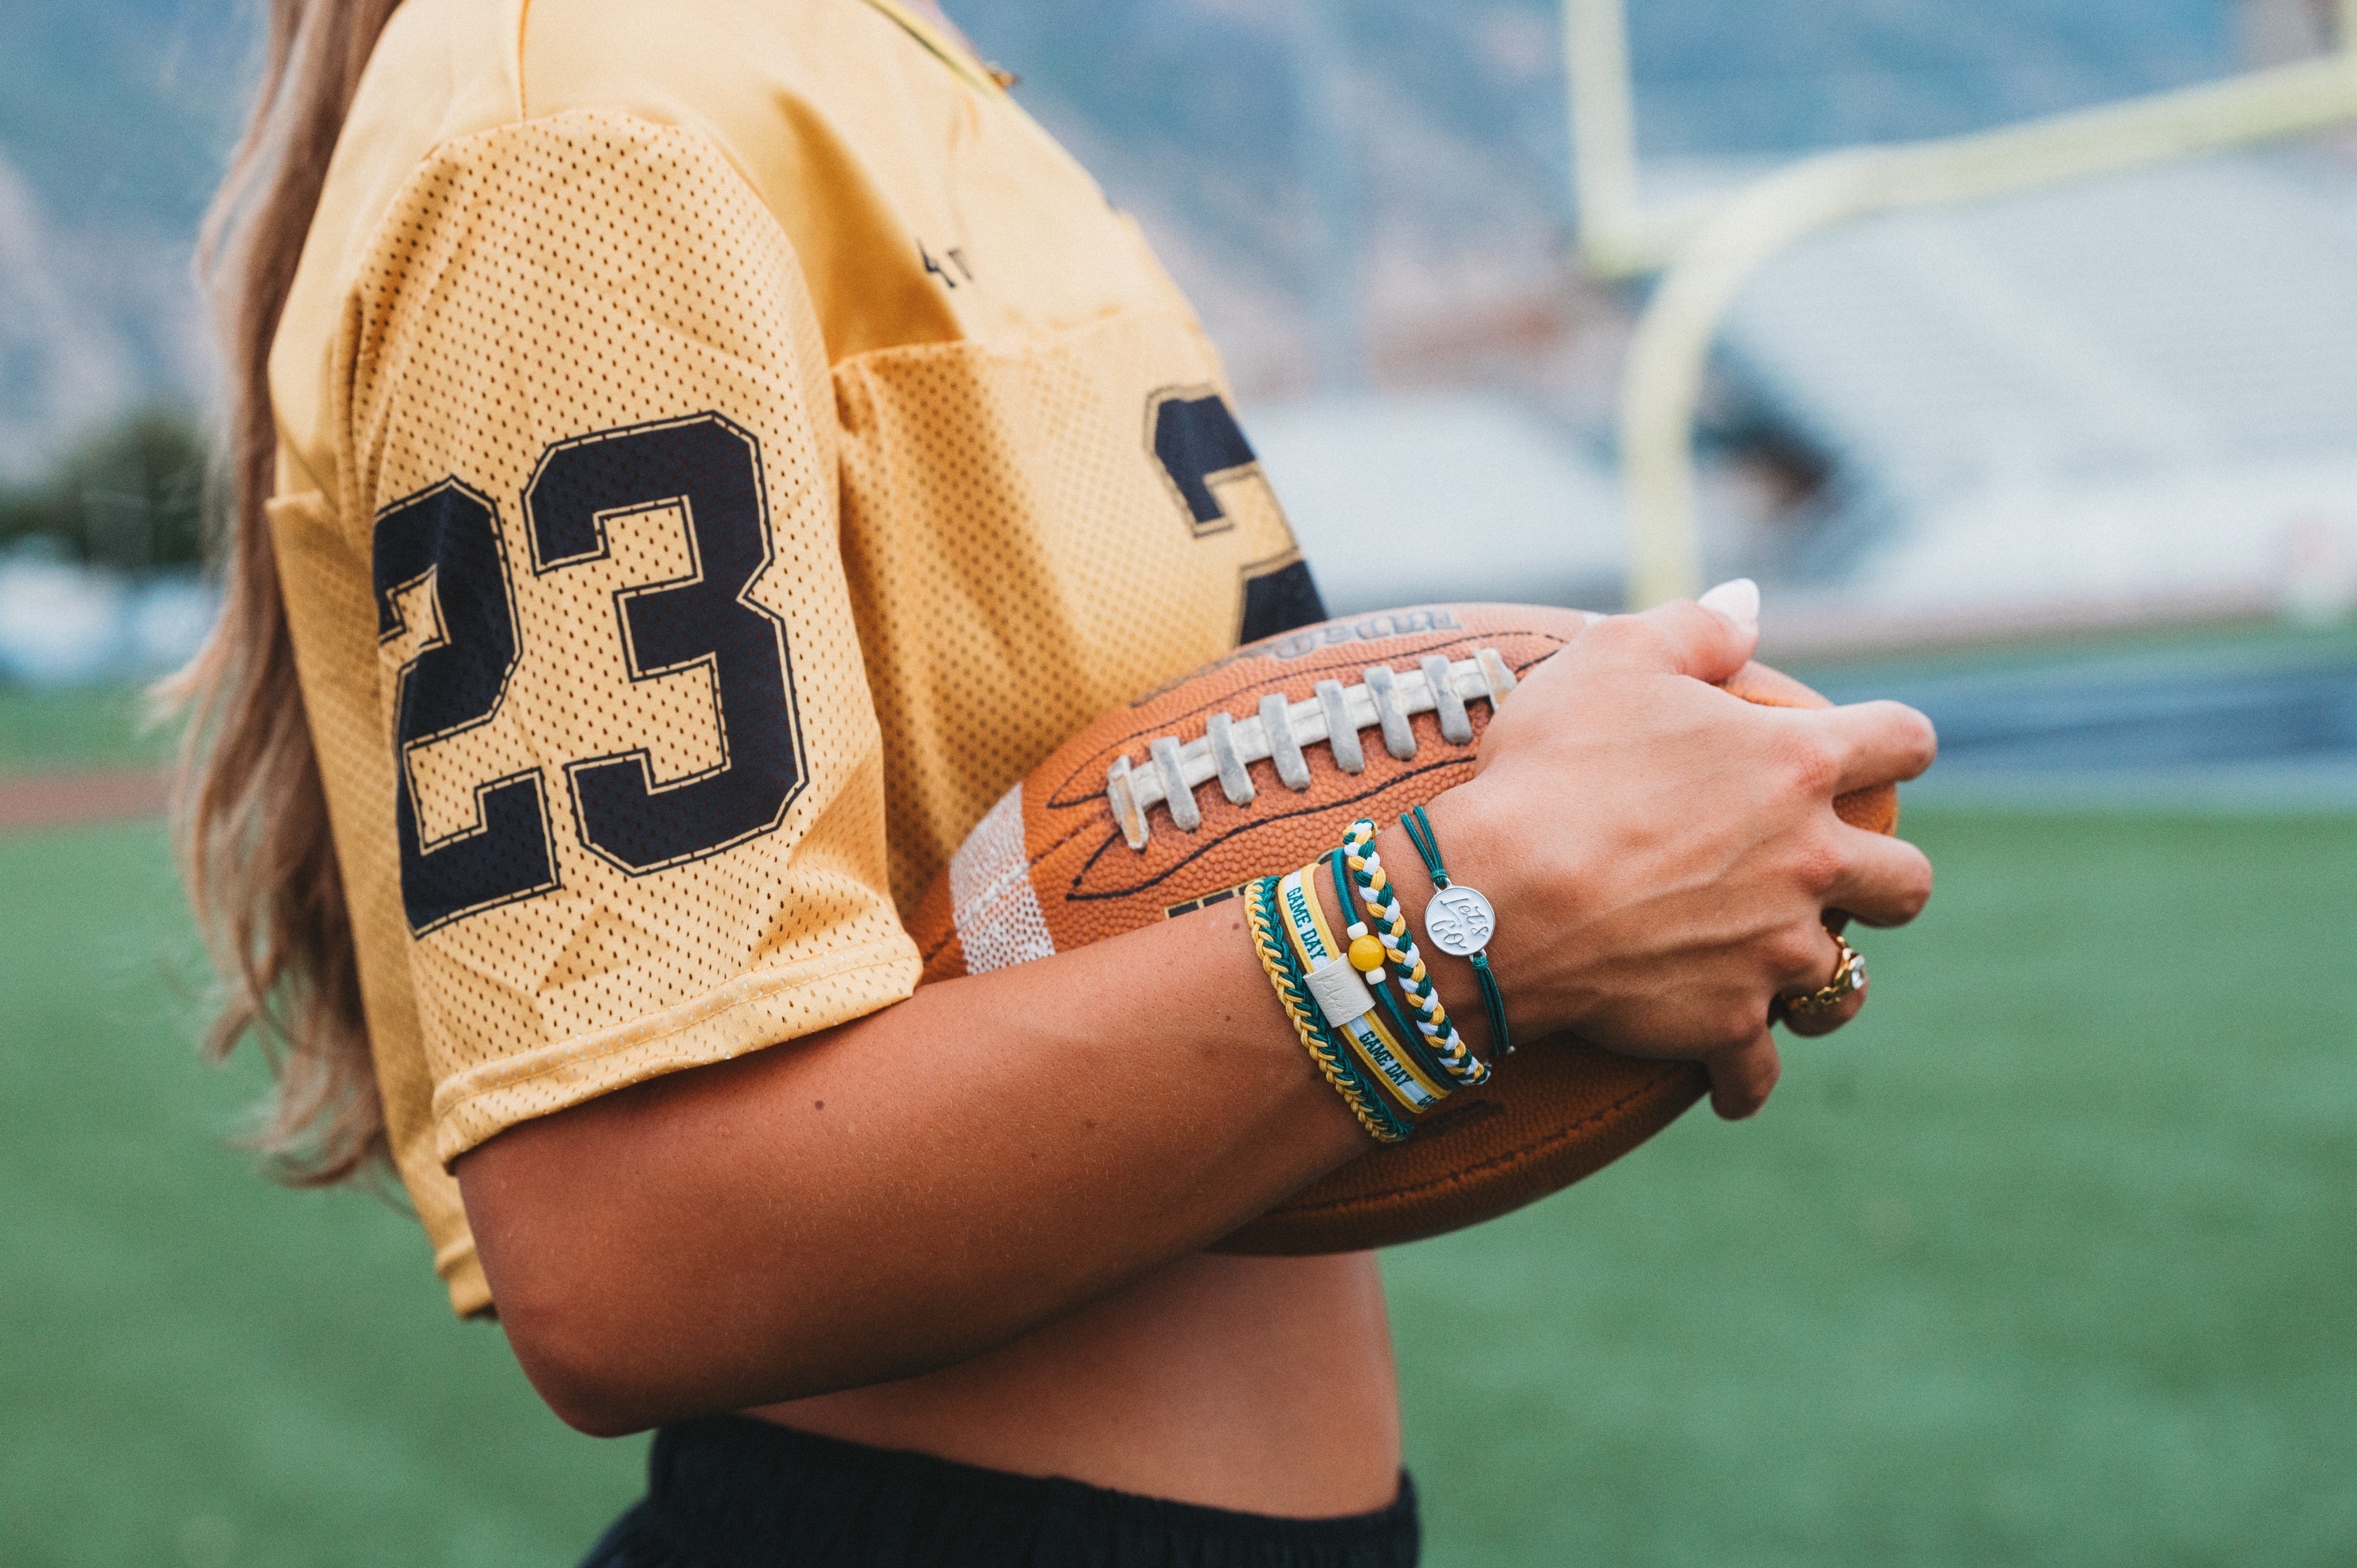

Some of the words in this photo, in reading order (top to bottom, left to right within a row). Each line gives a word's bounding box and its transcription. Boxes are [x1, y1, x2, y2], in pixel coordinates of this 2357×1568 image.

[372, 410, 809, 941] 23
[1286, 886, 1311, 928] GAME
[1300, 928, 1327, 960] DAY
[1359, 1030, 1395, 1067] GAME
[1384, 1062, 1414, 1087] DAY
